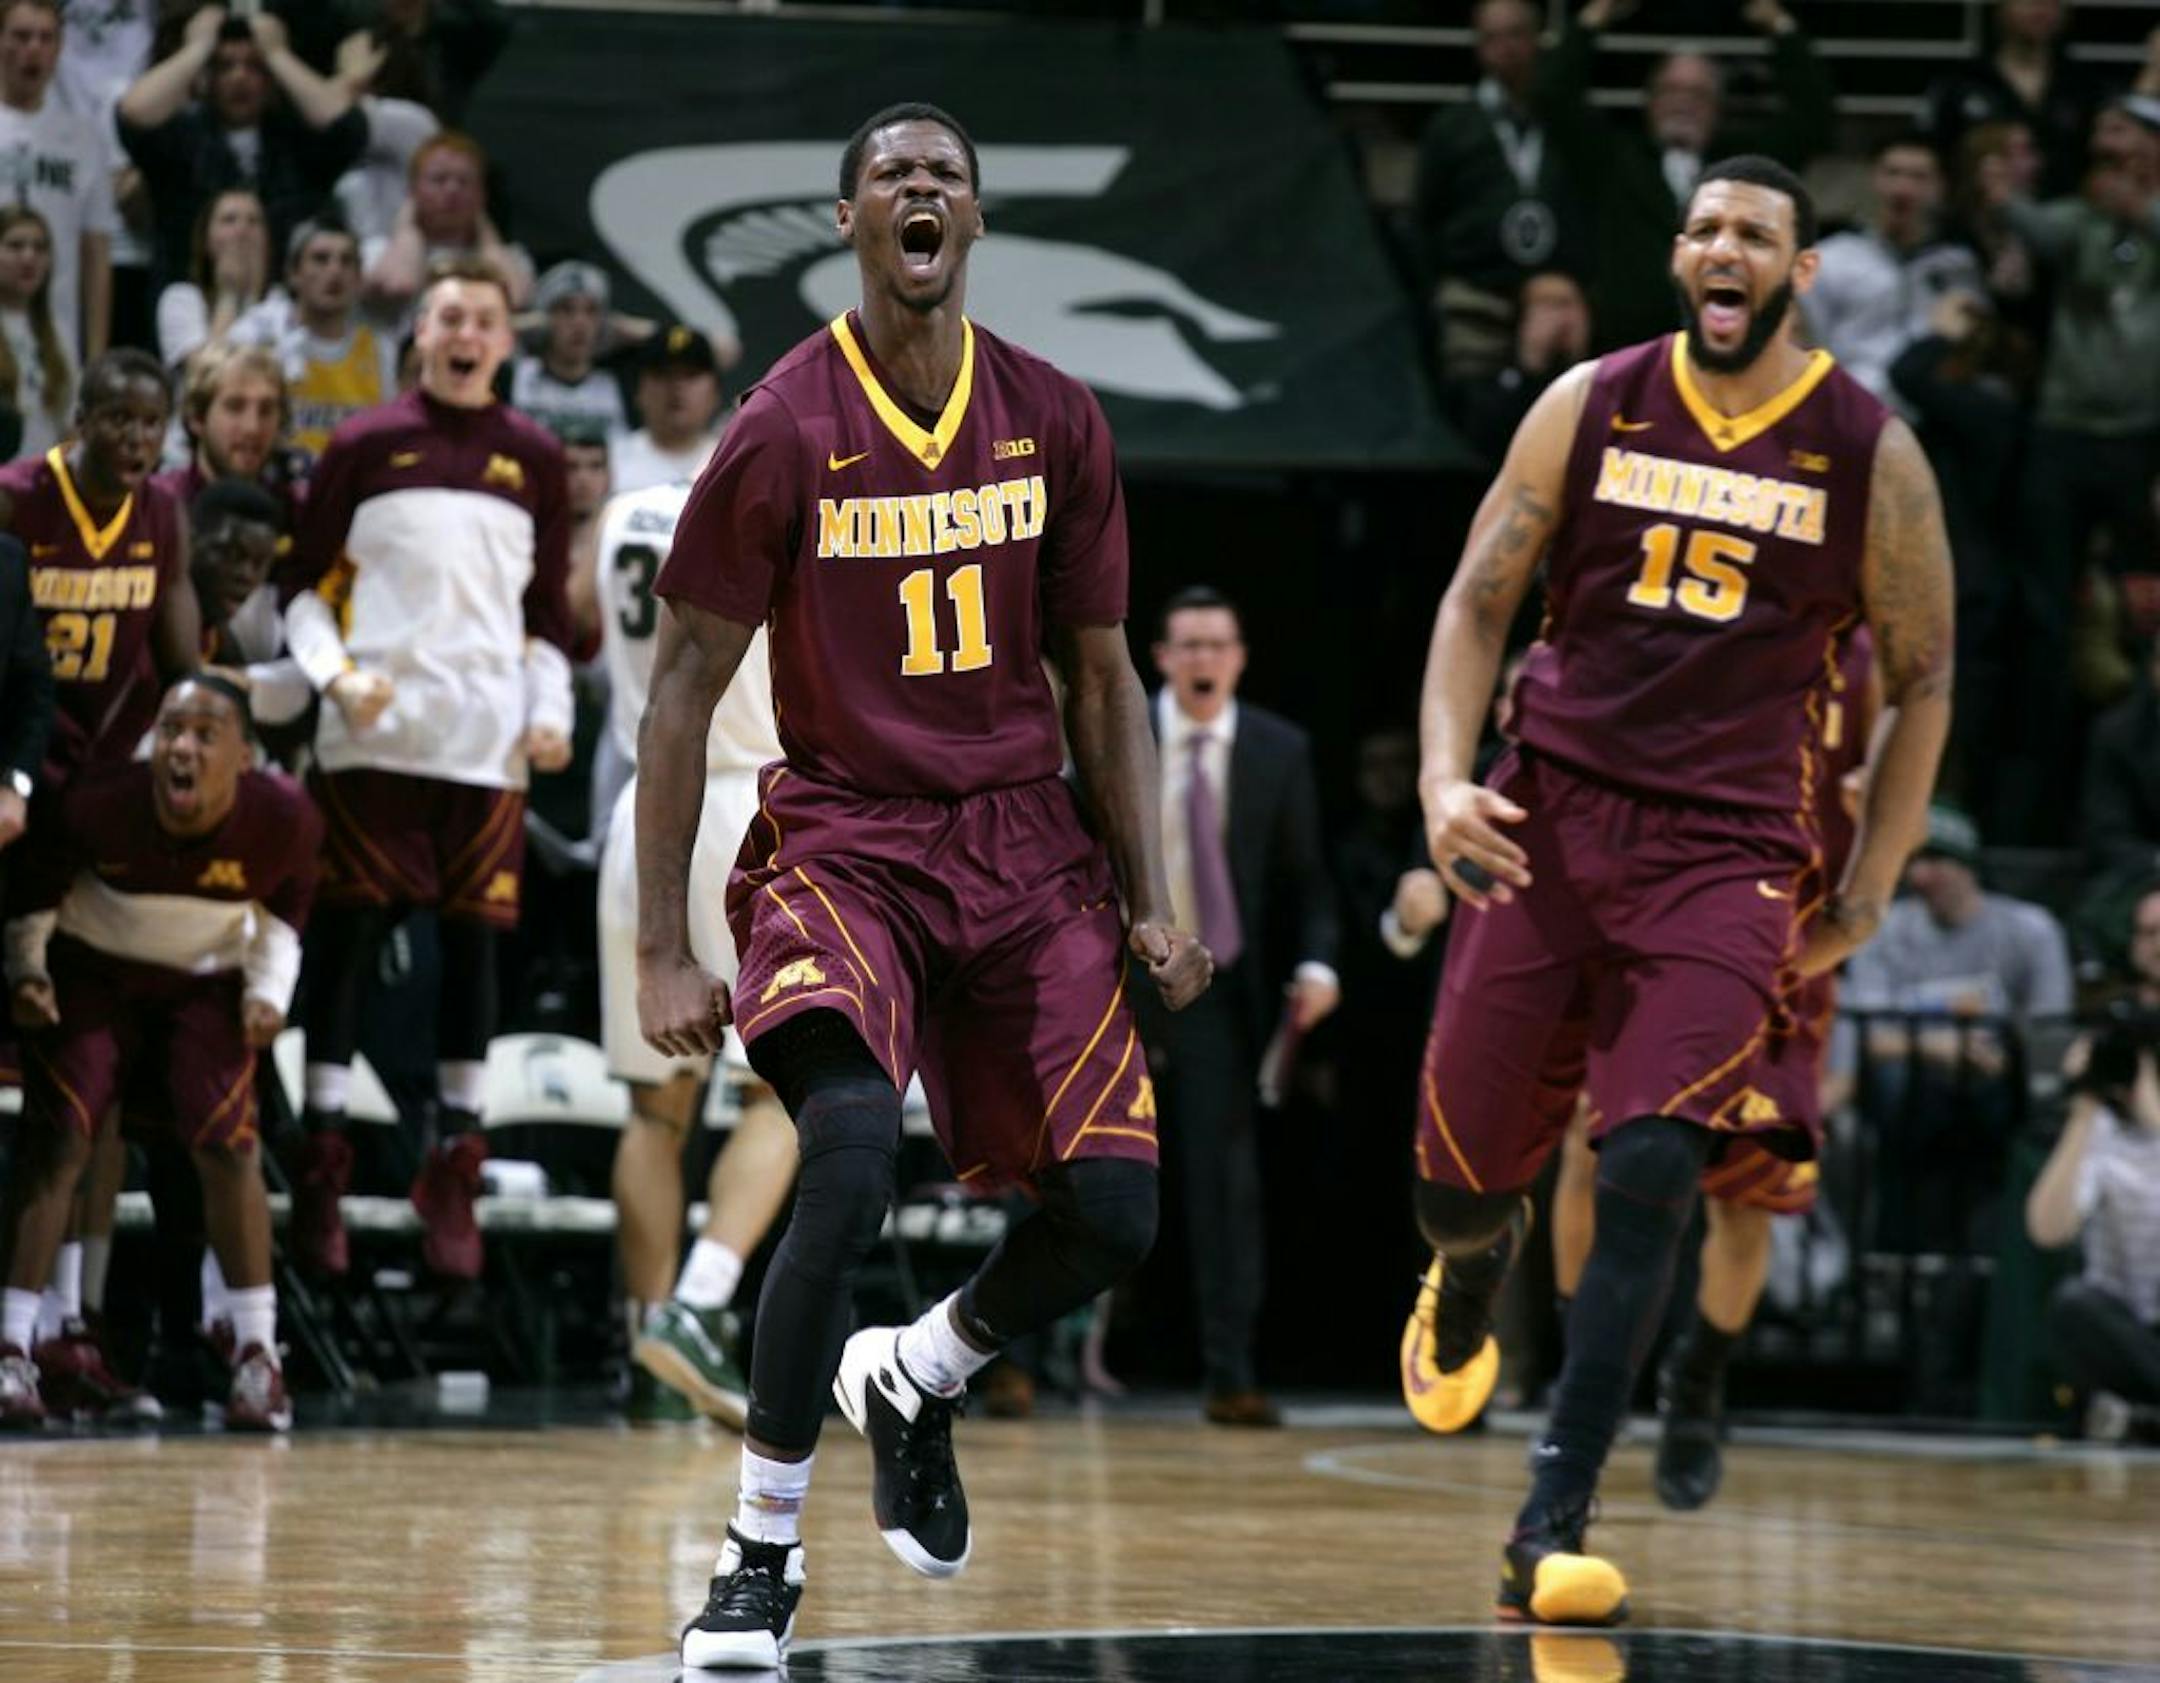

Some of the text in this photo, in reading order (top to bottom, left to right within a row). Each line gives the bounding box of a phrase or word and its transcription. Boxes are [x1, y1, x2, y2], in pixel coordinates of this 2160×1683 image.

[1593, 447, 1828, 546] MINNESOTA
[899, 564, 993, 676] 11
[1626, 522, 1758, 622] 15
[45, 611, 117, 681] 21
